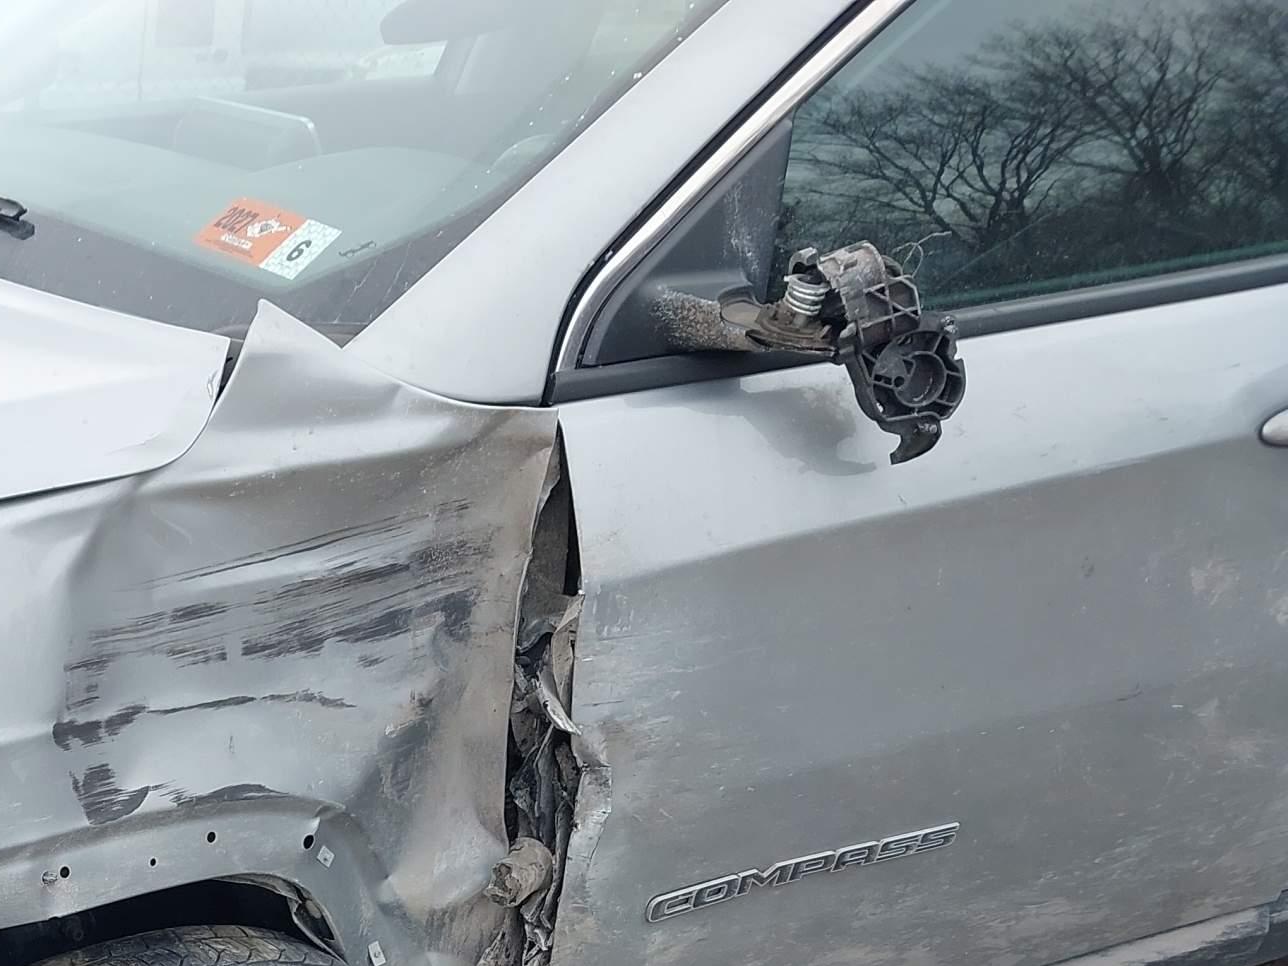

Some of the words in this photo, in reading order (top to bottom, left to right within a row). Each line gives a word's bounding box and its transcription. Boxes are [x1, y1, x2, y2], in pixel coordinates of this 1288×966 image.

[214, 206, 260, 234] 2027
[286, 239, 312, 262] 6
[645, 821, 960, 922] COMPASS
